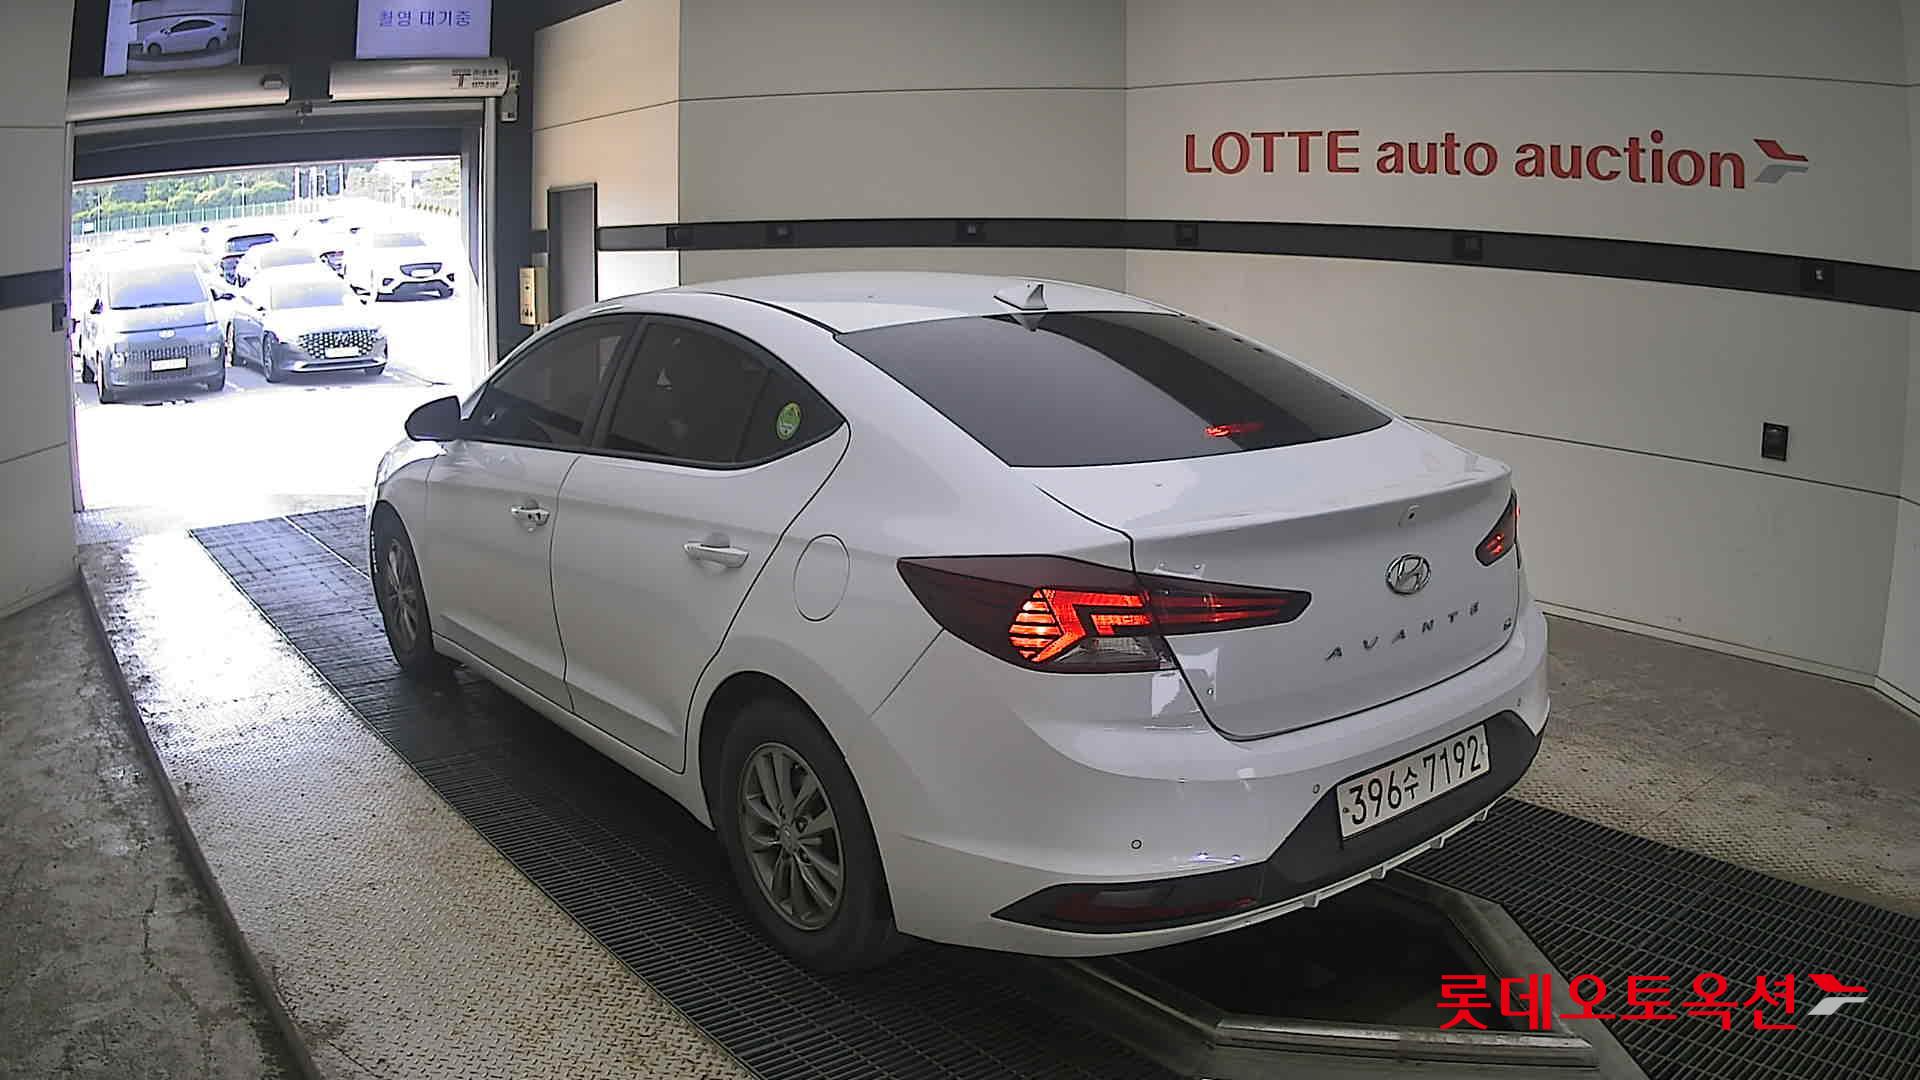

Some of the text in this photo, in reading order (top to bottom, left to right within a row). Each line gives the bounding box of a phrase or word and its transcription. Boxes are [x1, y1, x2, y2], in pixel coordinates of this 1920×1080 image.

[419, 9, 473, 27] 대기중
[1185, 129, 1746, 189] LOTTE auto auction
[1324, 601, 1481, 662] AVANTE
[1348, 733, 1483, 826] 396수7192
